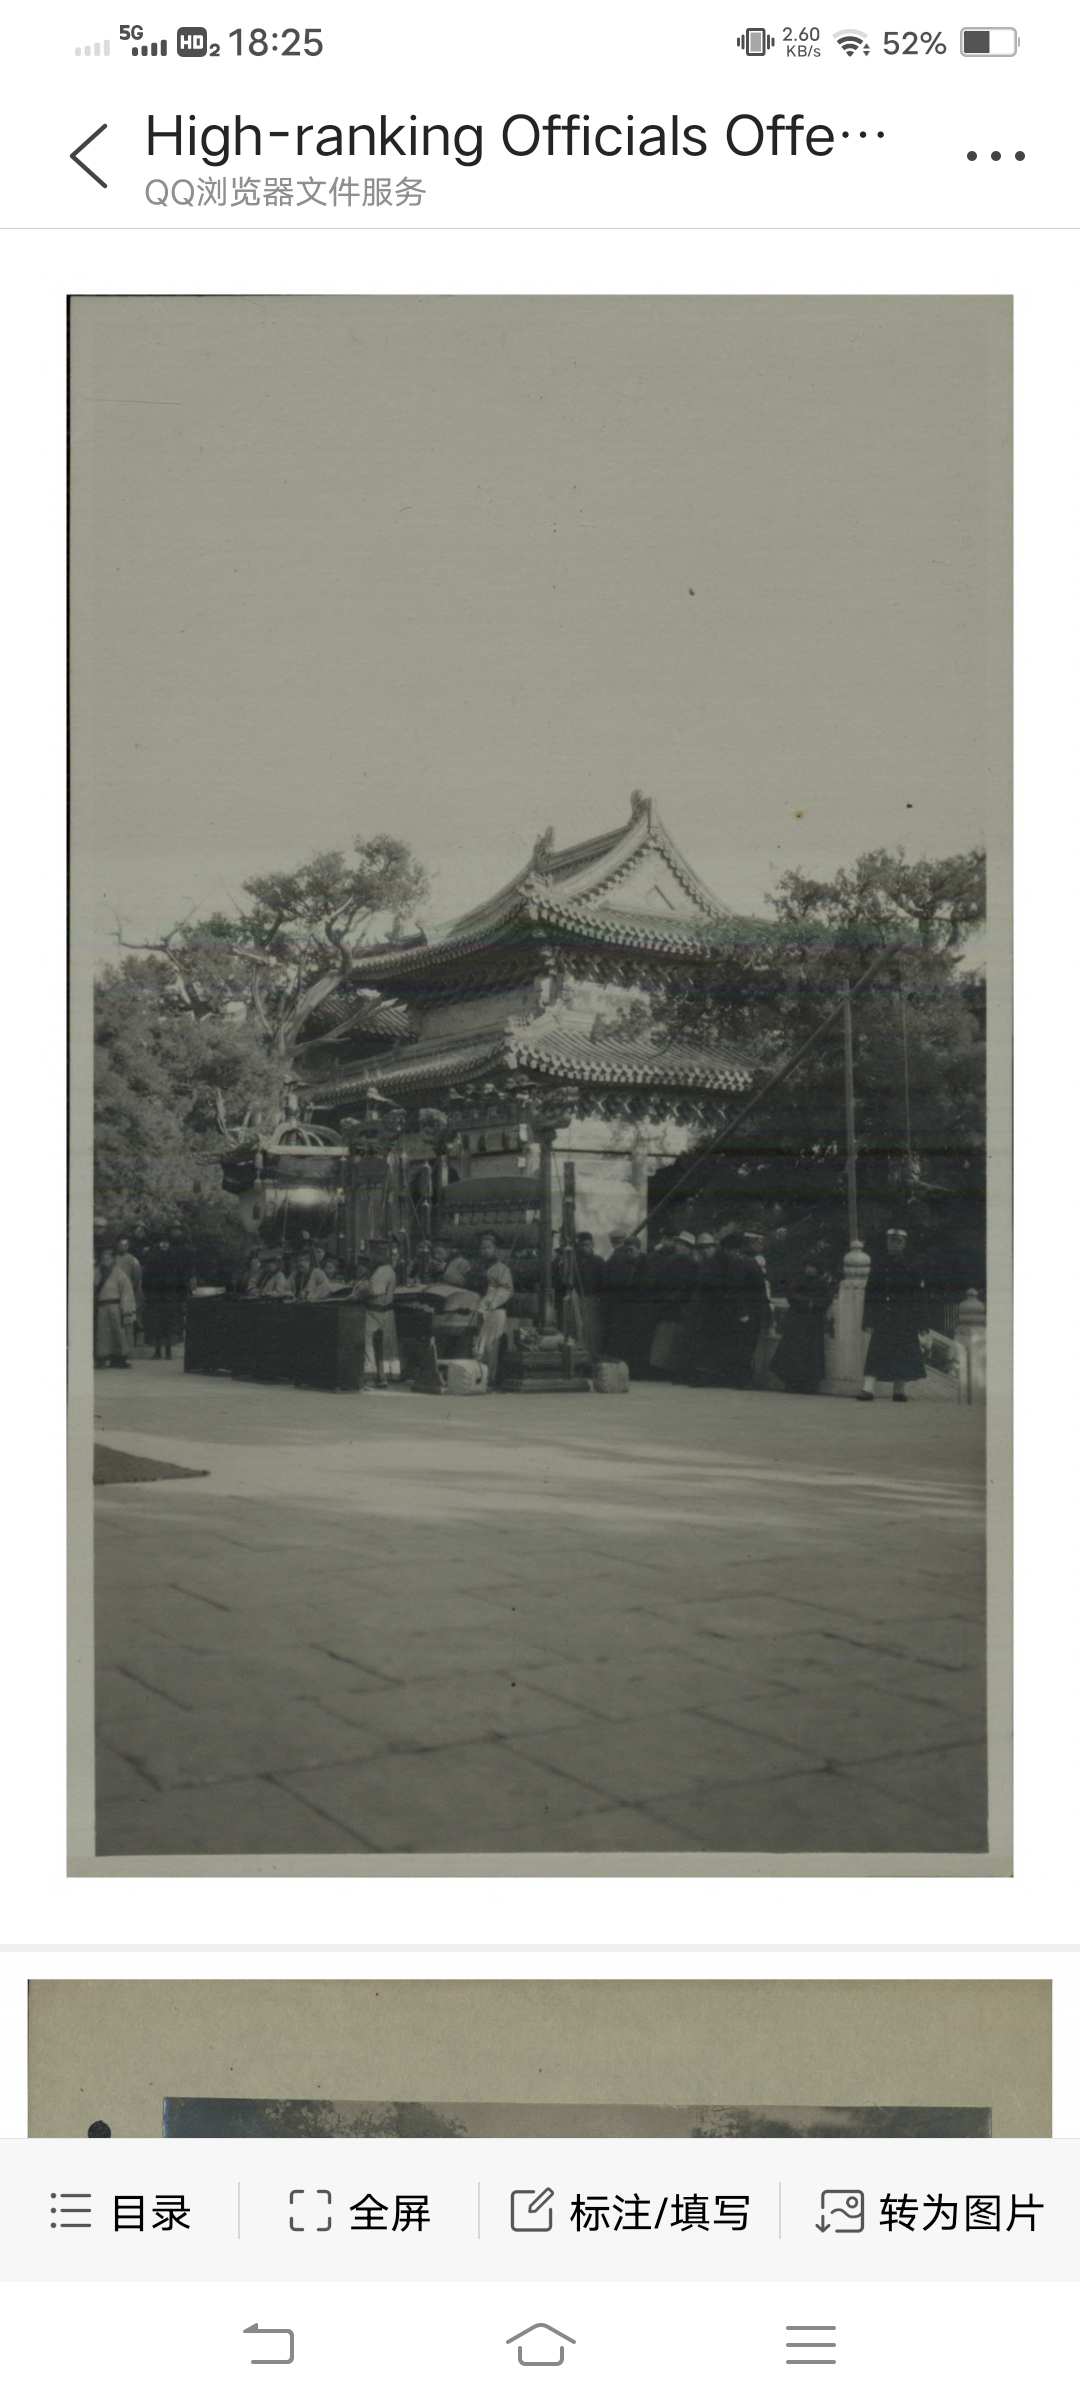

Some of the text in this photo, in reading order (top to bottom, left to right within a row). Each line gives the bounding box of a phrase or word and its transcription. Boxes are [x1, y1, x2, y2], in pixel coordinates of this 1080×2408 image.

[119, 24, 144, 41] 5G
[228, 27, 324, 57] 18:25
[782, 26, 820, 42] 2.60
[883, 31, 947, 56] 52%
[786, 44, 822, 58] KB/s
[147, 114, 483, 168] High-ranking
[502, 113, 708, 157] Officials
[145, 175, 427, 208] QQ浏览器文件服务
[114, 2194, 191, 2233] 目录
[349, 2193, 431, 2233] 全屏
[569, 2192, 750, 2233] 标注/填写
[879, 2192, 1045, 2233] 转为图片
